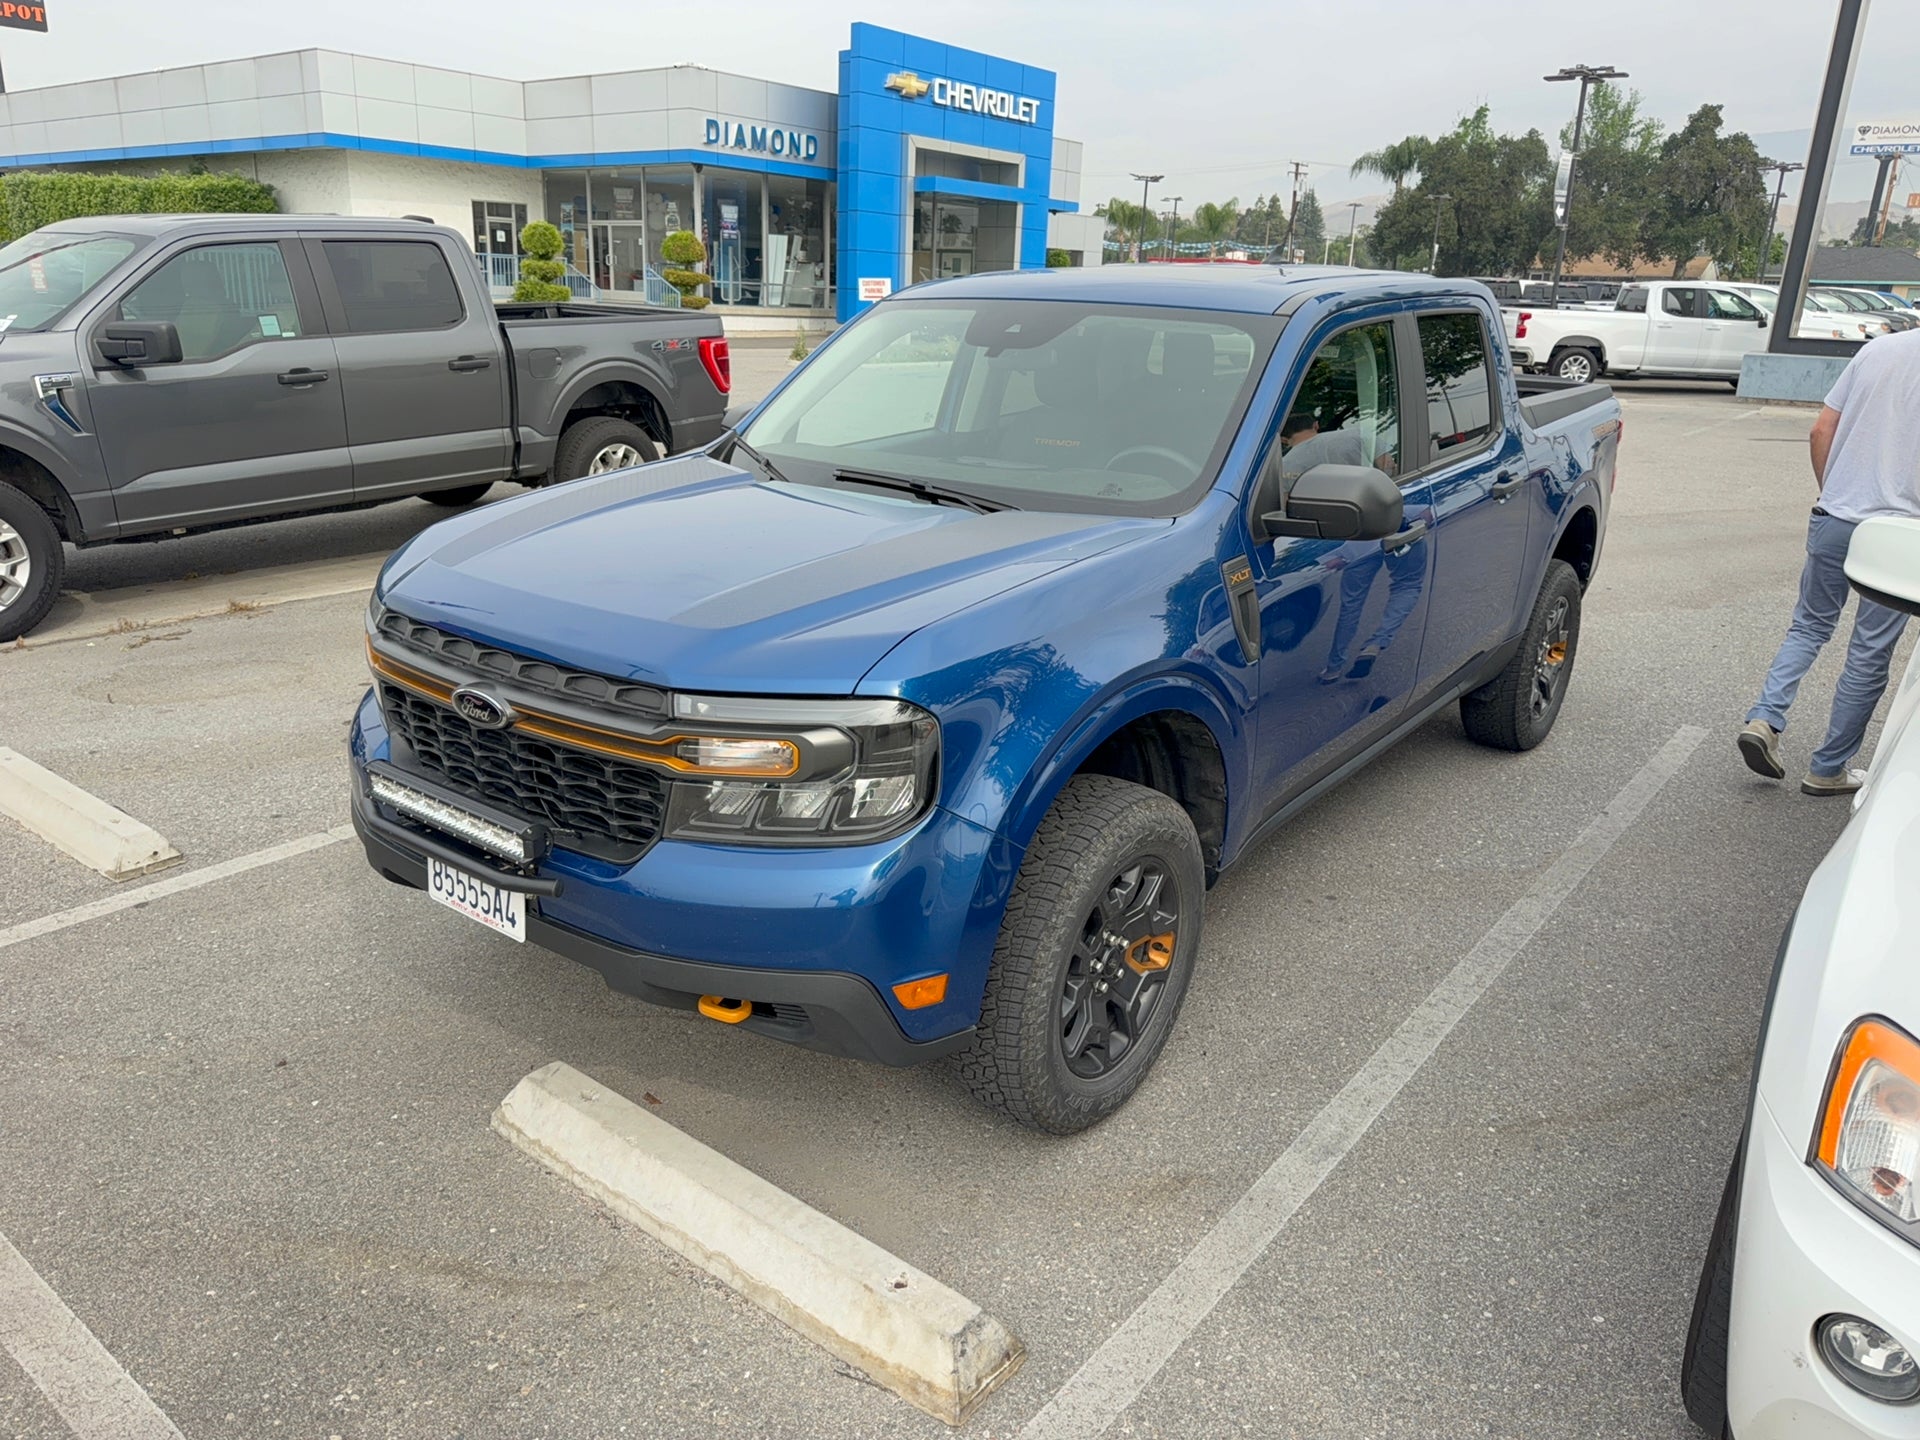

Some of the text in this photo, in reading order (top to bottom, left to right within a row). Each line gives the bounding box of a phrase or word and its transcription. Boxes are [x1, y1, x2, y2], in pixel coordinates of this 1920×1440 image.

[0, 2, 44, 22] POT
[932, 77, 1040, 124] CHEVROLET
[705, 118, 818, 160] DIAMOND
[1231, 568, 1251, 585] XLT
[461, 696, 490, 721] Ford
[433, 859, 517, 929] 85555A4
